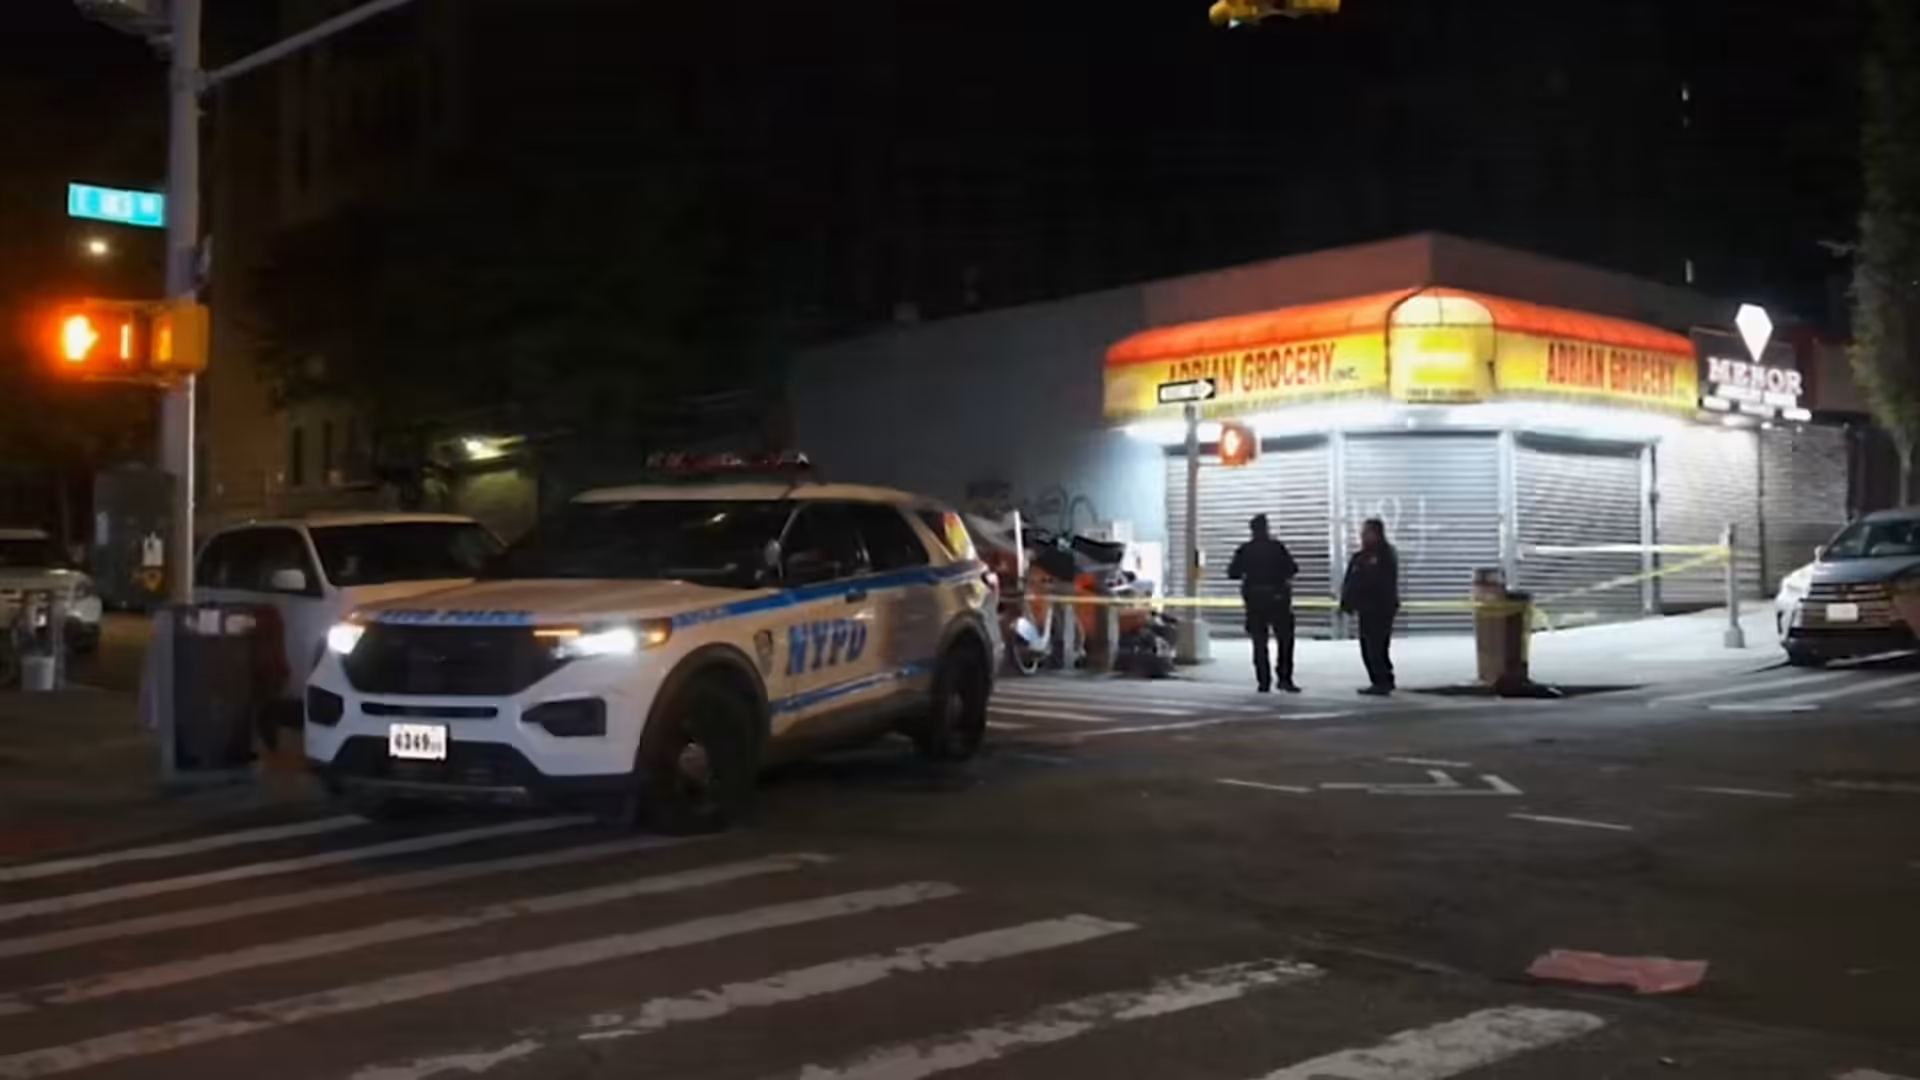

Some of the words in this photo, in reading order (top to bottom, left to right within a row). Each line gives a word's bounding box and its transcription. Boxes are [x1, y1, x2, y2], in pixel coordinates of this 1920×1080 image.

[1242, 342, 1335, 392] GROCERY
[1547, 342, 1604, 389] ADRIAN
[1610, 350, 1678, 397] GROCERY
[1707, 357, 1803, 395] MENOR
[787, 619, 868, 676] NYPD
